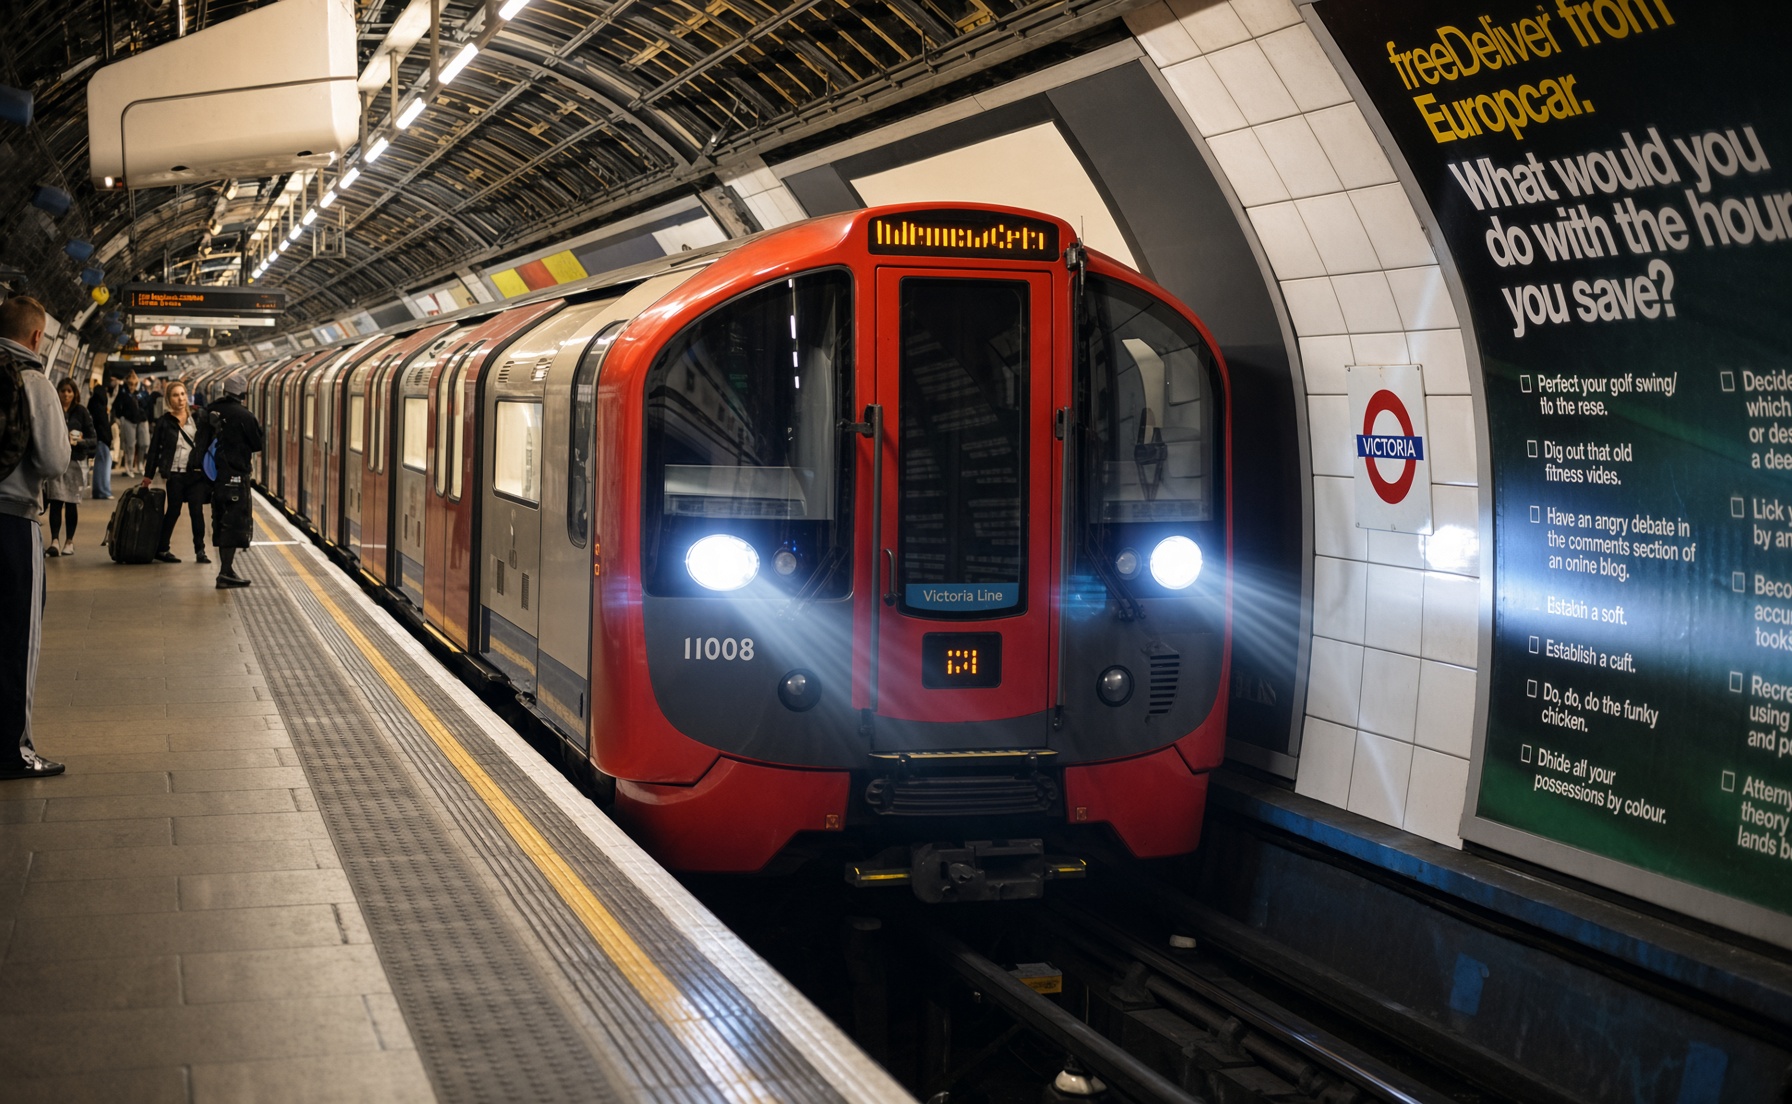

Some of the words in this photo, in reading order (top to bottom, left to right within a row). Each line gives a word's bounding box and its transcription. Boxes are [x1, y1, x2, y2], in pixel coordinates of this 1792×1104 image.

[1413, 73, 1596, 144] Europcar.
[1447, 152, 1559, 211] What
[1551, 126, 1681, 199] would
[1674, 125, 1772, 193] you
[1485, 215, 1534, 267] do
[1531, 204, 1619, 263] with
[1613, 197, 1690, 254] the
[1501, 282, 1571, 338] you
[1573, 259, 1676, 323] save?
[1537, 374, 1579, 393] Perfect
[1581, 377, 1607, 397] your
[1610, 373, 1632, 396] golf
[1556, 397, 1575, 415] the
[1578, 401, 1608, 415] rese.
[1746, 395, 1792, 417] which
[1363, 437, 1416, 457] VICTORIA
[1749, 427, 1765, 443] or
[1544, 441, 1564, 463] Dig
[1566, 443, 1585, 460] out
[1587, 442, 1611, 461] that
[1613, 443, 1632, 462] old
[1751, 452, 1760, 469] a
[1545, 463, 1583, 483] fitness
[1547, 507, 1575, 527] Have
[1578, 514, 1592, 528] an
[1595, 515, 1628, 536] angry
[1631, 514, 1675, 536] debate
[1678, 518, 1690, 537] in
[1753, 498, 1784, 521] Lick
[1547, 530, 1565, 548] the
[1568, 536, 1630, 556] comments
[1633, 540, 1678, 560] section
[1682, 543, 1696, 562] of
[1754, 524, 1772, 551] by
[1548, 555, 1562, 569] an
[1600, 557, 1630, 582] blog.
[923, 590, 973, 602] Victoria
[977, 590, 1003, 602] Line
[1591, 606, 1599, 620] a
[1601, 605, 1628, 625] soft.
[1754, 605, 1792, 626] accu
[684, 637, 755, 661] 11008
[1546, 639, 1597, 665] Establish
[1600, 653, 1607, 667] a
[1543, 682, 1561, 706] Do,
[1564, 688, 1581, 710] do,
[1585, 692, 1600, 711] do
[1602, 696, 1621, 716] the
[1624, 700, 1659, 729] funky
[1749, 704, 1790, 732] using
[1541, 706, 1588, 732] chicken.
[1748, 730, 1776, 751] and
[1778, 737, 1792, 758] p
[1588, 765, 1616, 785] your
[1534, 774, 1605, 807] possessions
[1607, 789, 1622, 815] by
[1624, 798, 1667, 825] colour.
[1741, 801, 1790, 837] theory
[1737, 825, 1777, 856] lands
[1780, 837, 1792, 861] b
